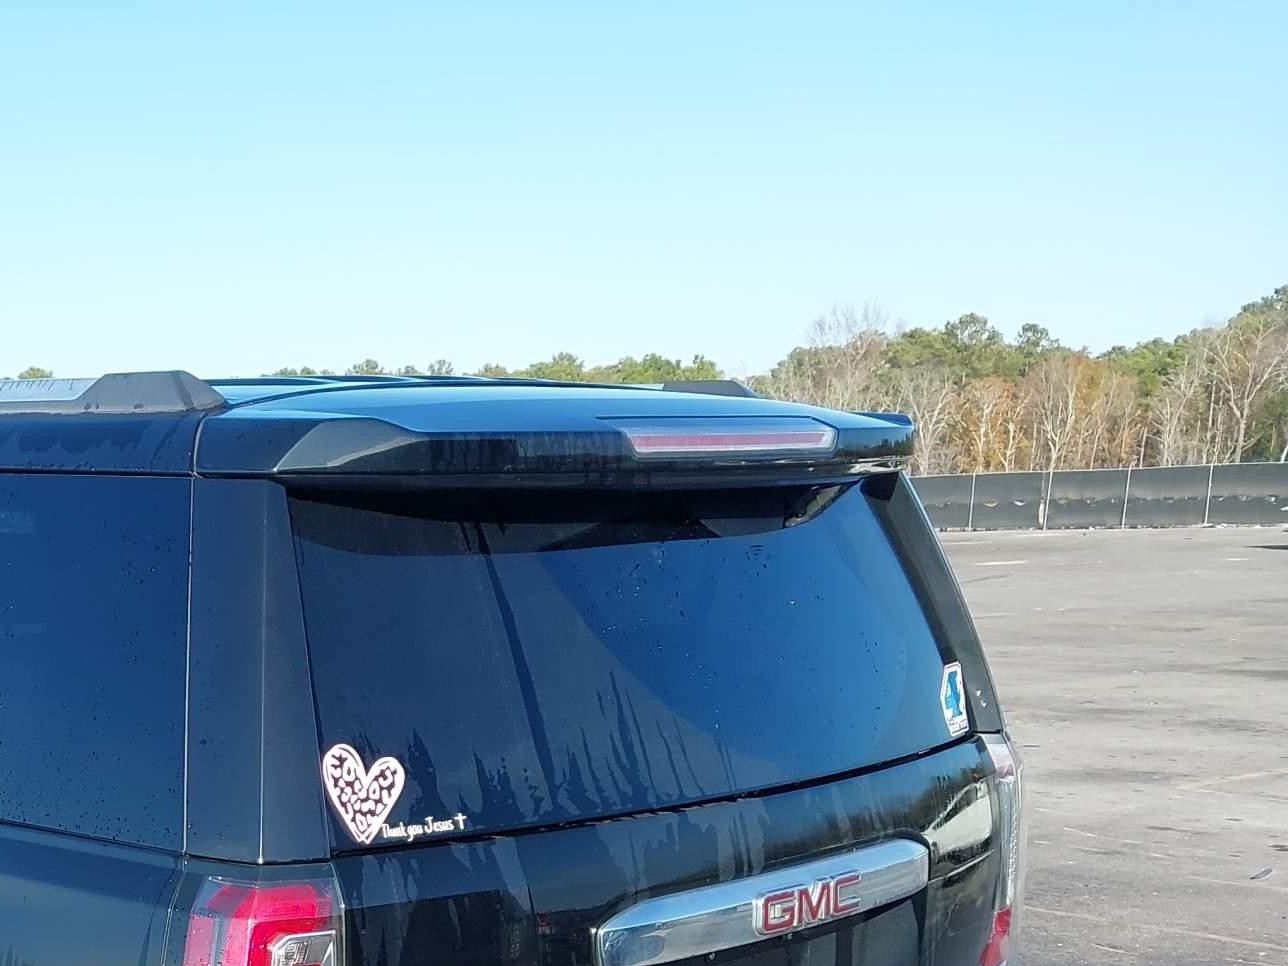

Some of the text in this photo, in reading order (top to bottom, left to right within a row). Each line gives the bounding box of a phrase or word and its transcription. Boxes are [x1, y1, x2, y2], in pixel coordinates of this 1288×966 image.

[407, 824, 423, 841] you
[425, 817, 454, 833] Jesus
[754, 872, 862, 937] GMC
